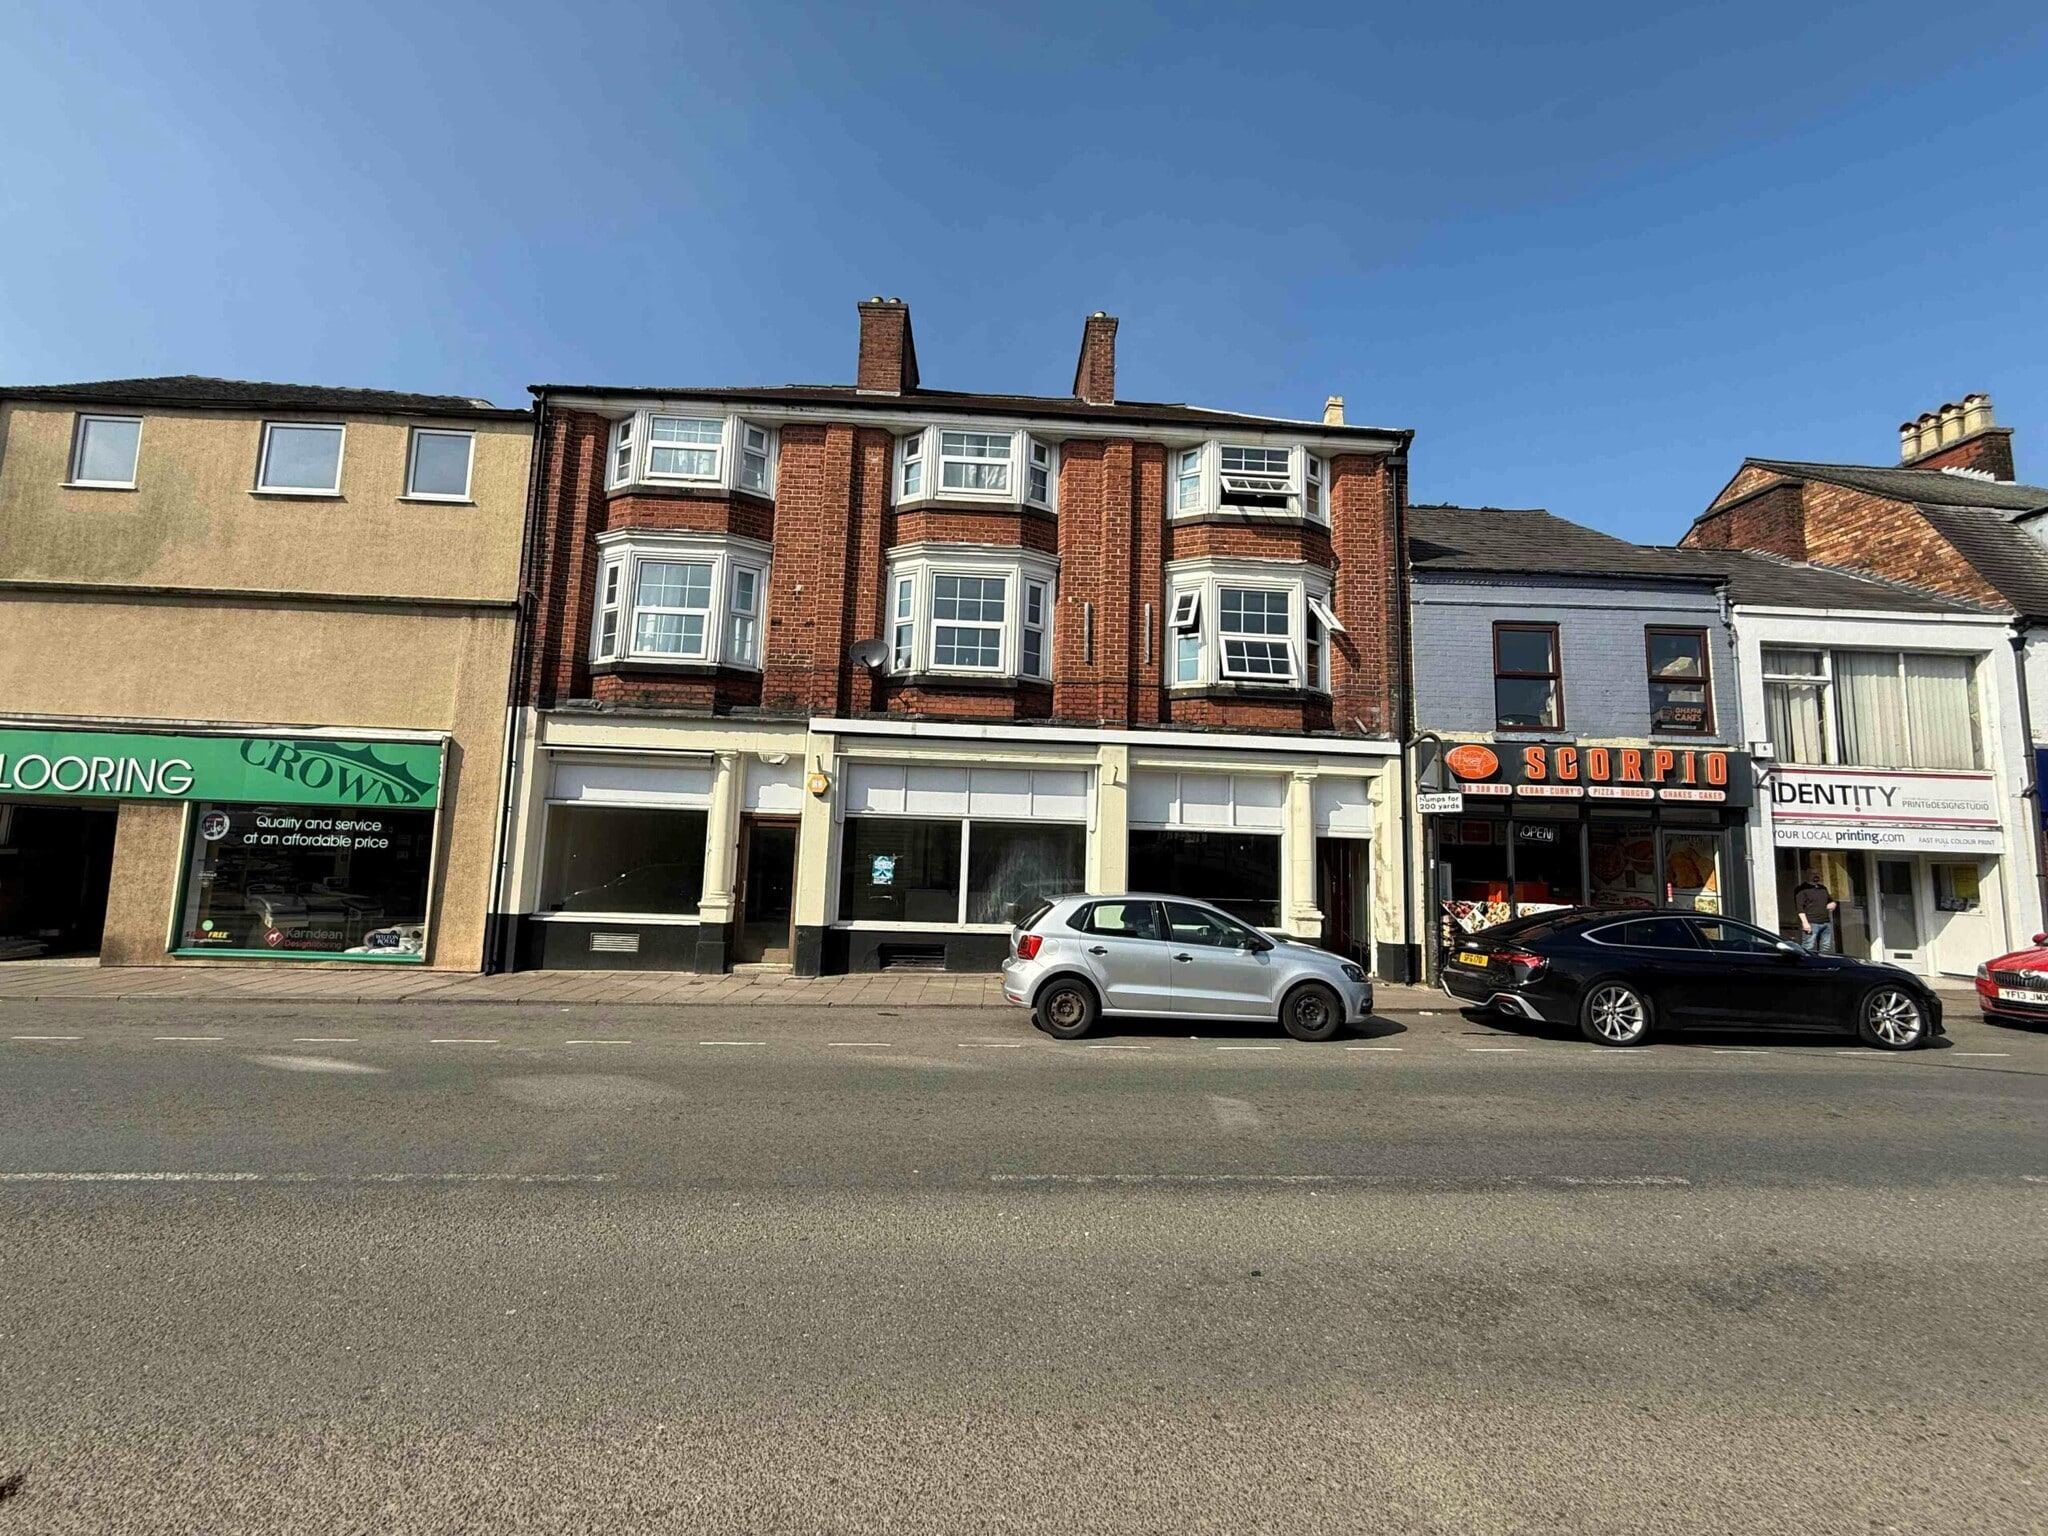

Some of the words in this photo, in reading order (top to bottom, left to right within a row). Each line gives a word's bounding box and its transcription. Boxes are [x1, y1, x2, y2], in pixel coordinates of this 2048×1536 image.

[1674, 713, 1702, 722] CAKES
[1524, 746, 1727, 785] SCORPIO
[0, 754, 193, 795] LOORING
[1519, 786, 1545, 795] KEBAB
[1593, 788, 1614, 796] PIZZA
[1620, 789, 1650, 798] BURGER
[1663, 790, 1693, 799] SHAKES
[1699, 792, 1723, 800] CAKES
[1438, 803, 1460, 811] yards
[256, 815, 302, 831] Quality
[304, 817, 332, 830] and
[334, 819, 382, 832] service
[1522, 825, 1552, 839] OPEN
[1802, 831, 1832, 840] LOCAL
[1836, 829, 1905, 844] printing.com
[243, 832, 258, 845] at
[260, 834, 279, 846] an
[281, 833, 352, 848] affordable
[354, 836, 389, 850] price
[208, 931, 230, 939] FREE
[285, 928, 344, 941] Karndean
[2005, 990, 2026, 1000] YF13
